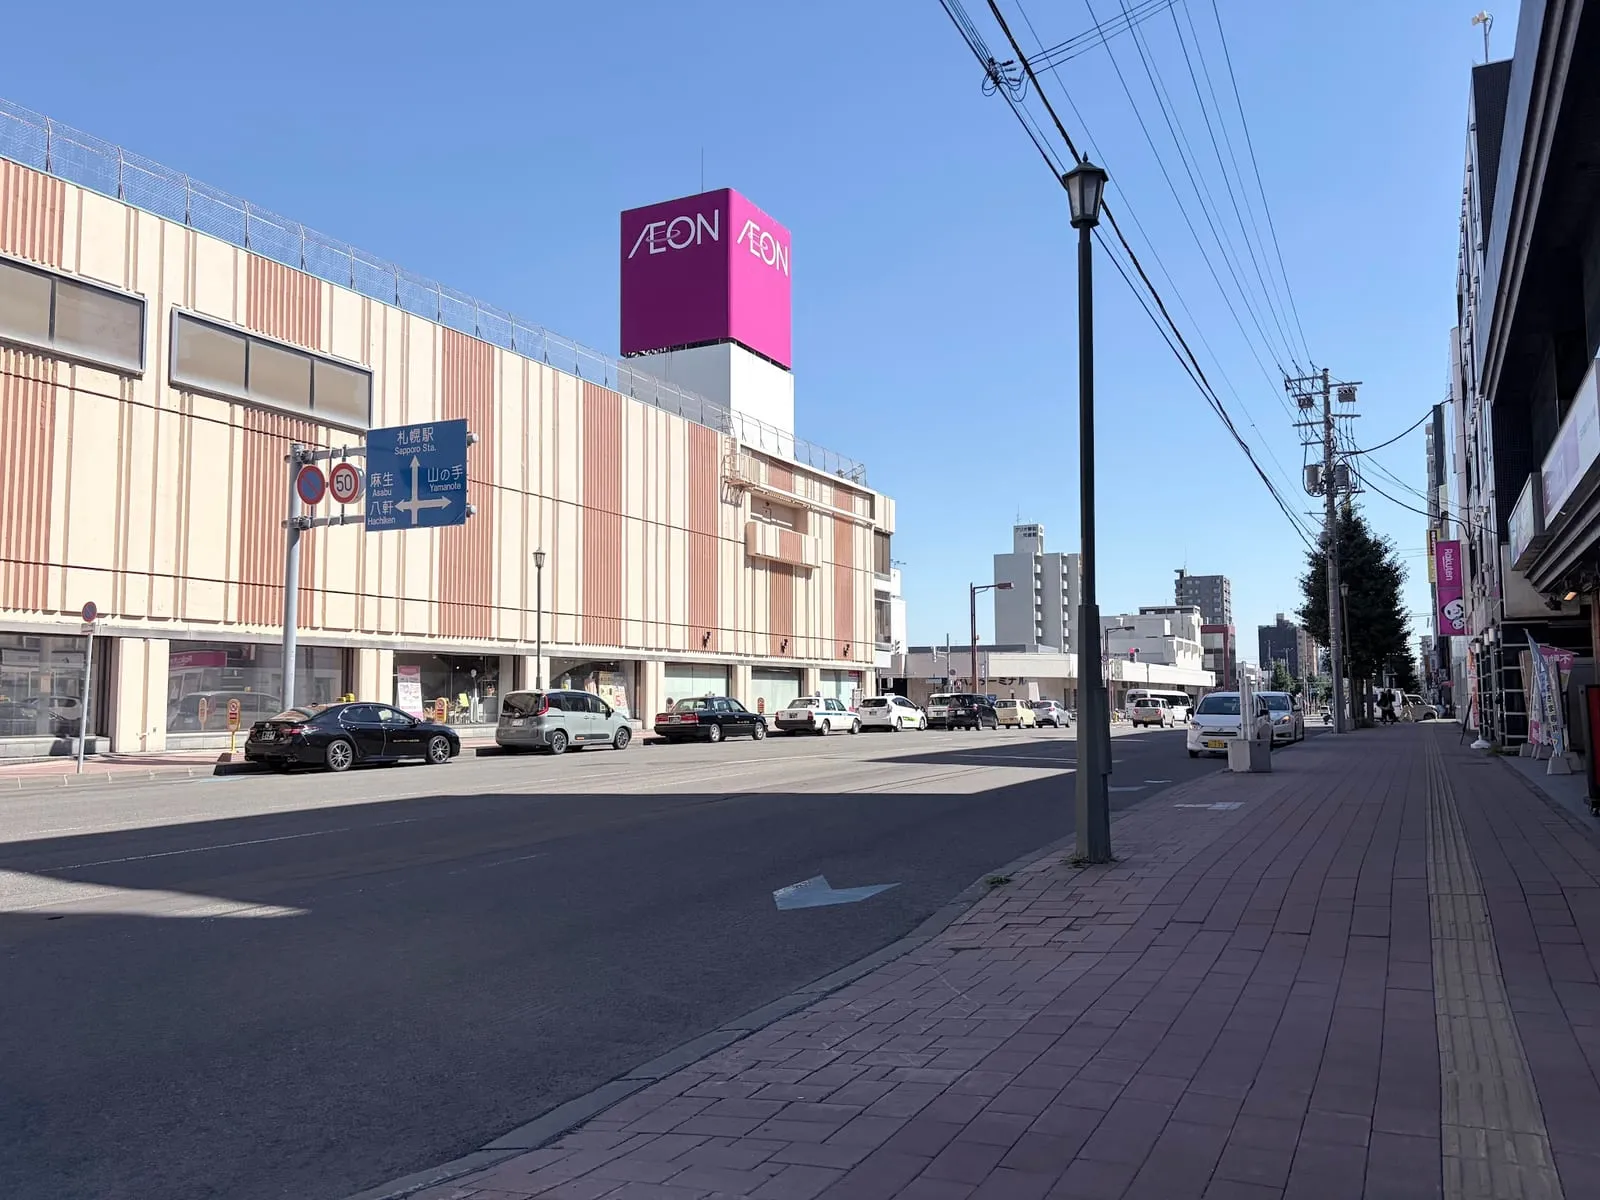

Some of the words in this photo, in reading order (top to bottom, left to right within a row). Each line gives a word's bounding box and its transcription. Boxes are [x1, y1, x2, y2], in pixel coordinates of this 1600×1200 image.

[396, 427, 434, 445] 札幌駅
[394, 446, 421, 456] Sapporo
[422, 443, 437, 452] Sta.
[370, 471, 394, 487] 麻生
[427, 465, 463, 482] 山の手
[336, 473, 353, 492] 50
[429, 481, 462, 492] Yamanote
[372, 488, 392, 497] Asabu
[369, 500, 394, 516] 八軒
[367, 516, 396, 526] Hachiken
[1444, 548, 1454, 581] Rakuten
